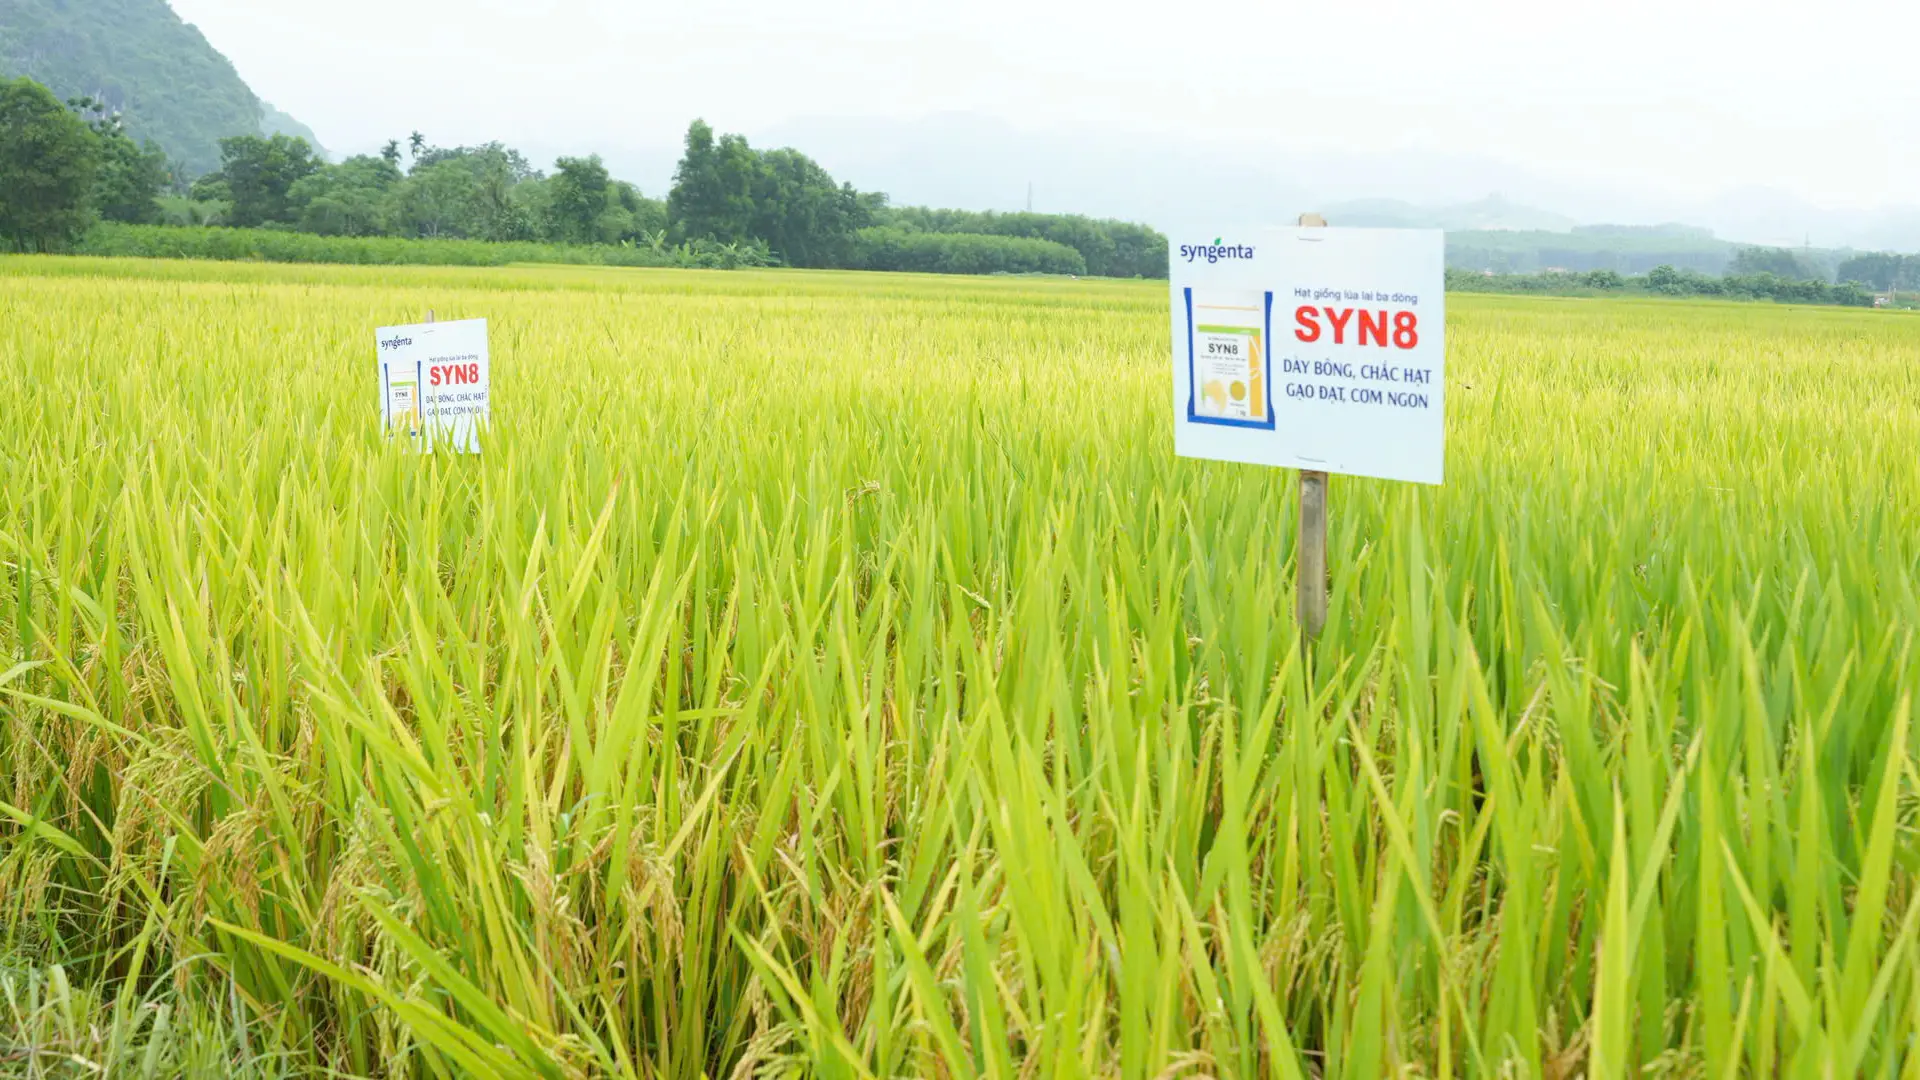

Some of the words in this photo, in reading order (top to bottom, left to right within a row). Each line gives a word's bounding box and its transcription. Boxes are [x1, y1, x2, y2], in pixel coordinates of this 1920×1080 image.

[1180, 242, 1254, 263] syngenta
[1294, 287, 1311, 298] Hạt
[1314, 287, 1341, 302] giống
[1344, 289, 1359, 300] lúa
[1362, 291, 1373, 301] lai
[1376, 291, 1389, 302] ba
[1392, 292, 1418, 305] dòng
[1294, 305, 1419, 349] SYN8
[381, 337, 412, 350] syngenta
[1208, 343, 1239, 356] SYN8
[429, 363, 479, 386] SYN8
[1283, 356, 1310, 374] DÀY
[1314, 358, 1356, 380] BÔNG,
[1361, 360, 1400, 382] CHẮC
[1404, 368, 1432, 387] HẠT
[1286, 382, 1314, 401] GẠO
[1319, 385, 1346, 404] ĐẠT,
[1350, 387, 1383, 405] CƠM
[1388, 391, 1429, 409] NGON
